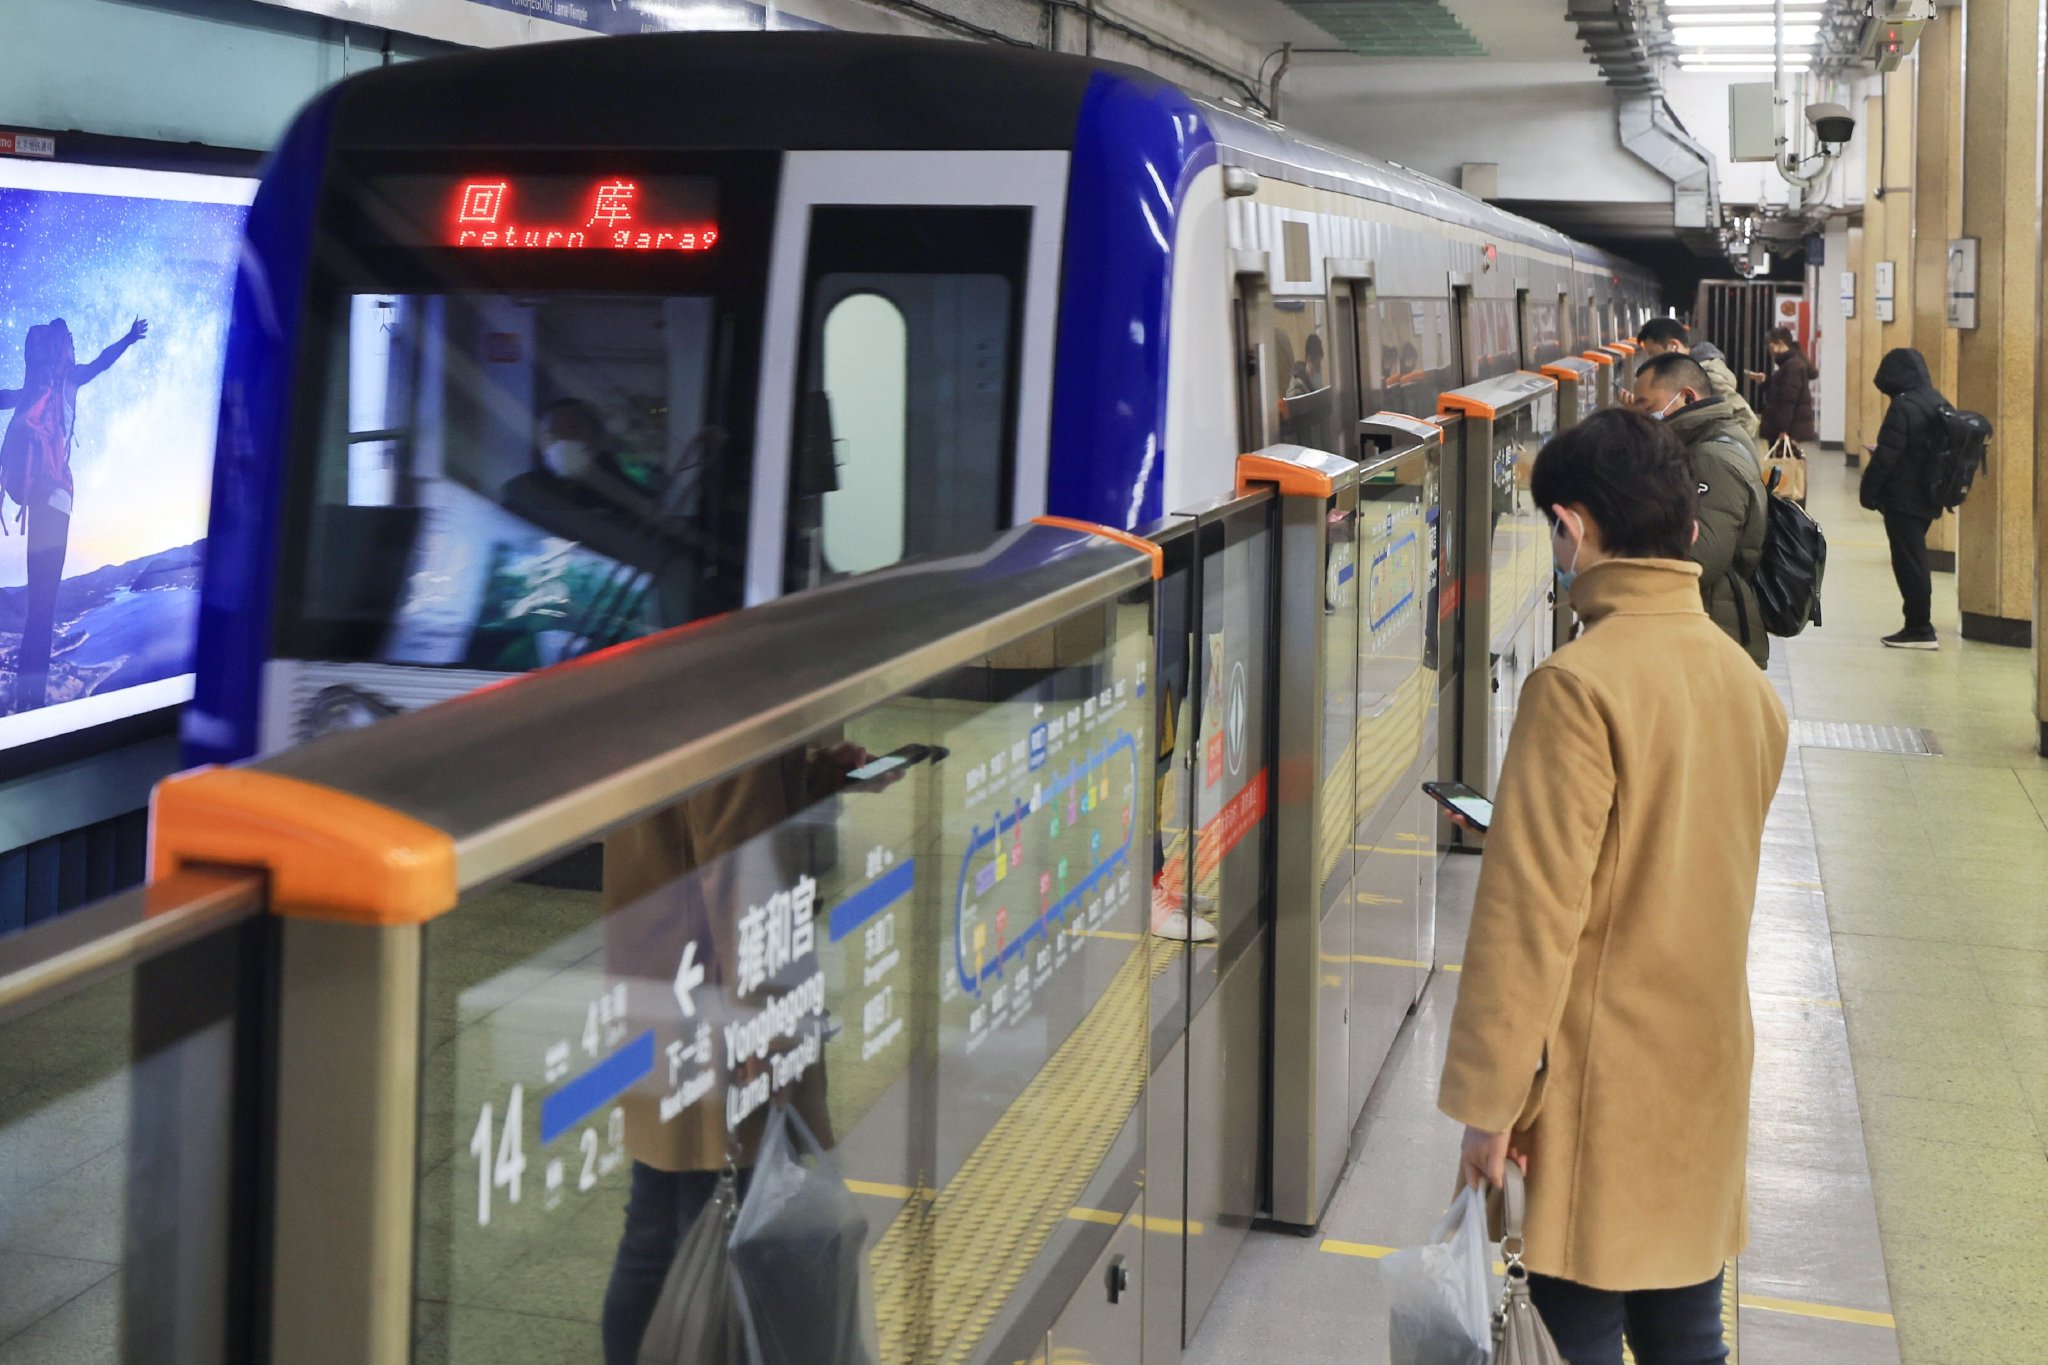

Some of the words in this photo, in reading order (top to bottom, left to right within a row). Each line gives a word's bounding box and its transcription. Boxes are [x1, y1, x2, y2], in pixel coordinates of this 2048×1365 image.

[553, 0, 569, 17] Lama
[569, 3, 588, 25] Temple
[458, 181, 507, 223] 回
[586, 180, 635, 228] 库
[458, 226, 585, 248] return
[723, 971, 825, 1071] Yonghegong
[470, 1082, 527, 1226] 14
